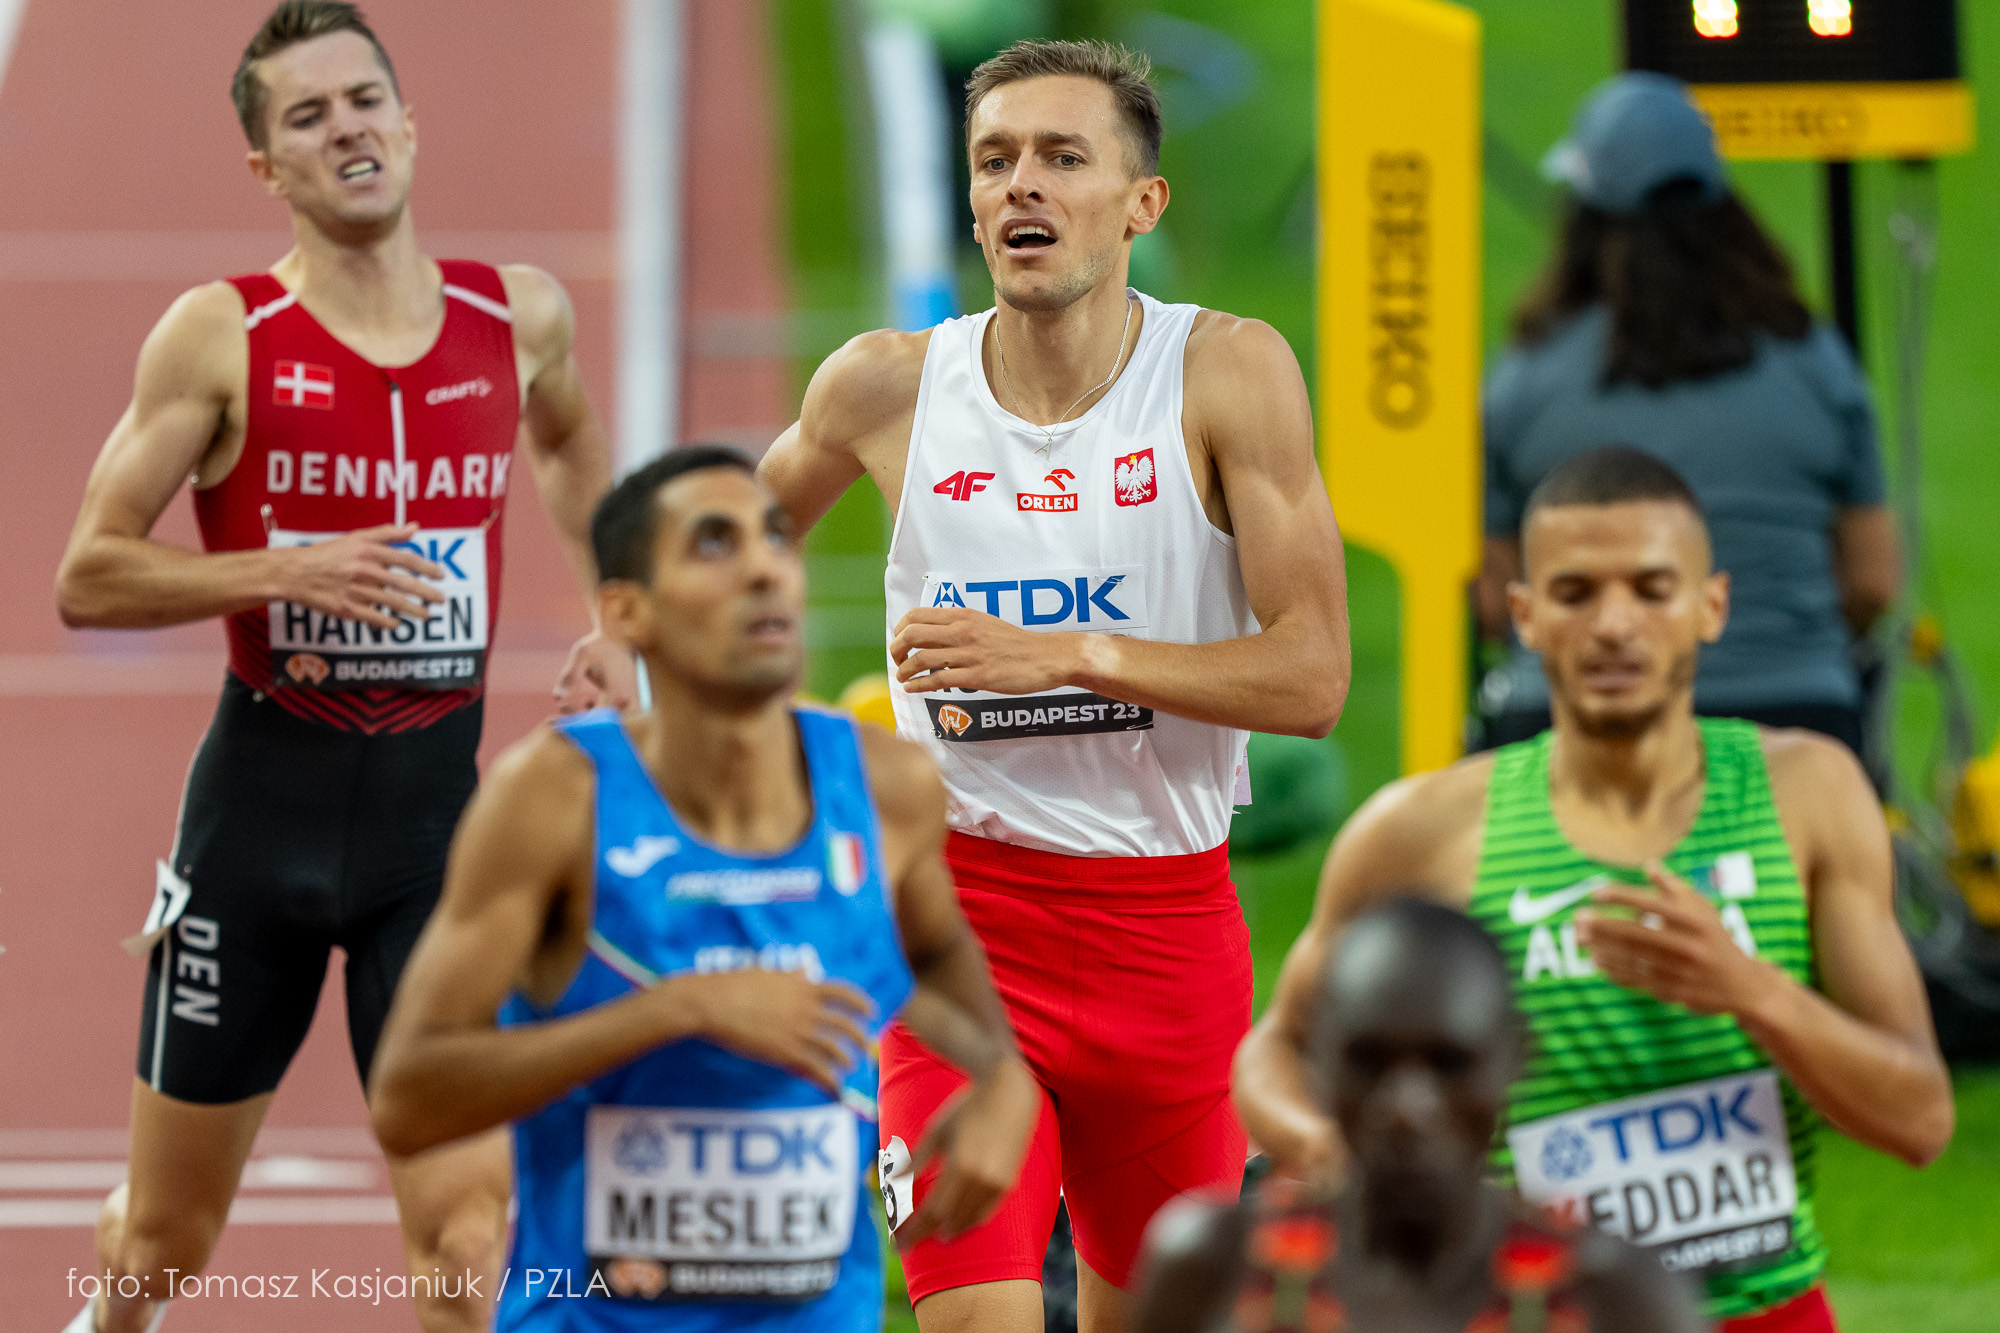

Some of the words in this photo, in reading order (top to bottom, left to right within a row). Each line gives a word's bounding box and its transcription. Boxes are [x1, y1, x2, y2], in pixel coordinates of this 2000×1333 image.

[266, 448, 513, 502] DENMARK
[933, 470, 996, 502] 4F
[1019, 496, 1075, 511] ORLEN
[965, 573, 1131, 627] TDK
[334, 657, 450, 682] BUDAPEST
[980, 704, 1109, 730] BUDAPEST
[1112, 703, 1141, 721] 23
[171, 914, 222, 1028] DEN
[672, 1120, 838, 1179] TDK
[1588, 1083, 1763, 1163] TDK
[605, 1185, 839, 1249] MESLEK
[1586, 1151, 1779, 1239] EDDAR
